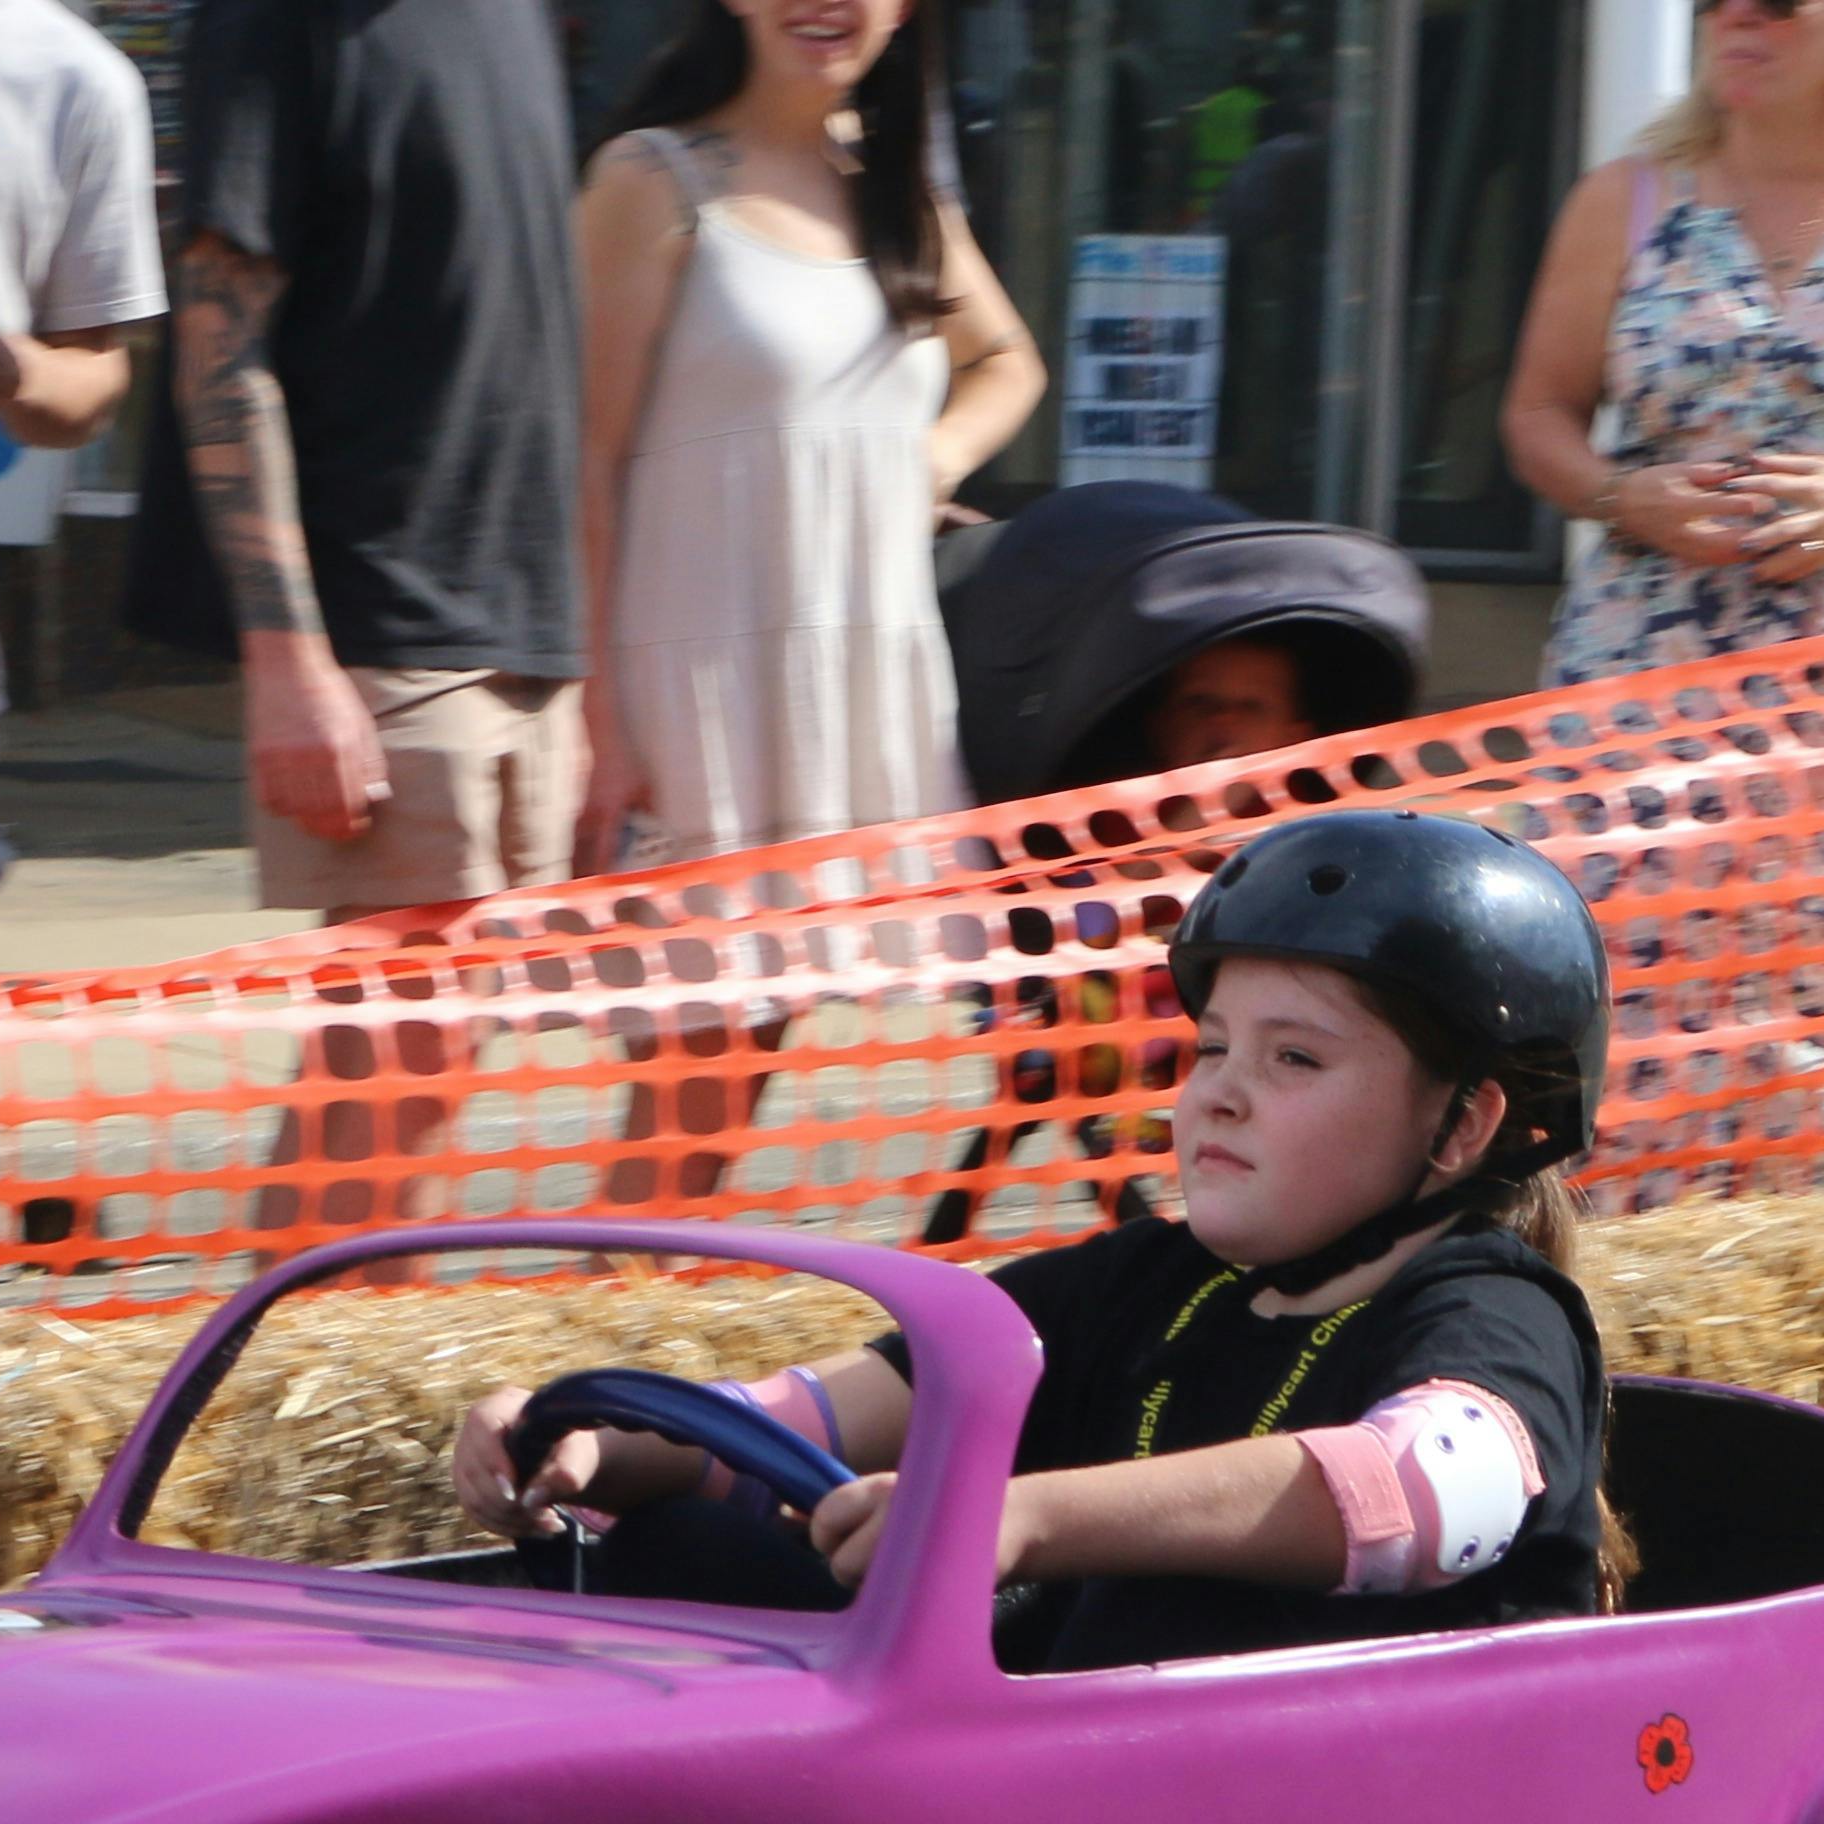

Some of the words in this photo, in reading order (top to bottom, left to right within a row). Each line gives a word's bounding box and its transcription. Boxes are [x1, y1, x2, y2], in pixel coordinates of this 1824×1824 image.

[1133, 1380, 1173, 1459] illycart
[1250, 1349, 1318, 1439] Billycart
[1310, 1298, 1372, 1347] Cham
